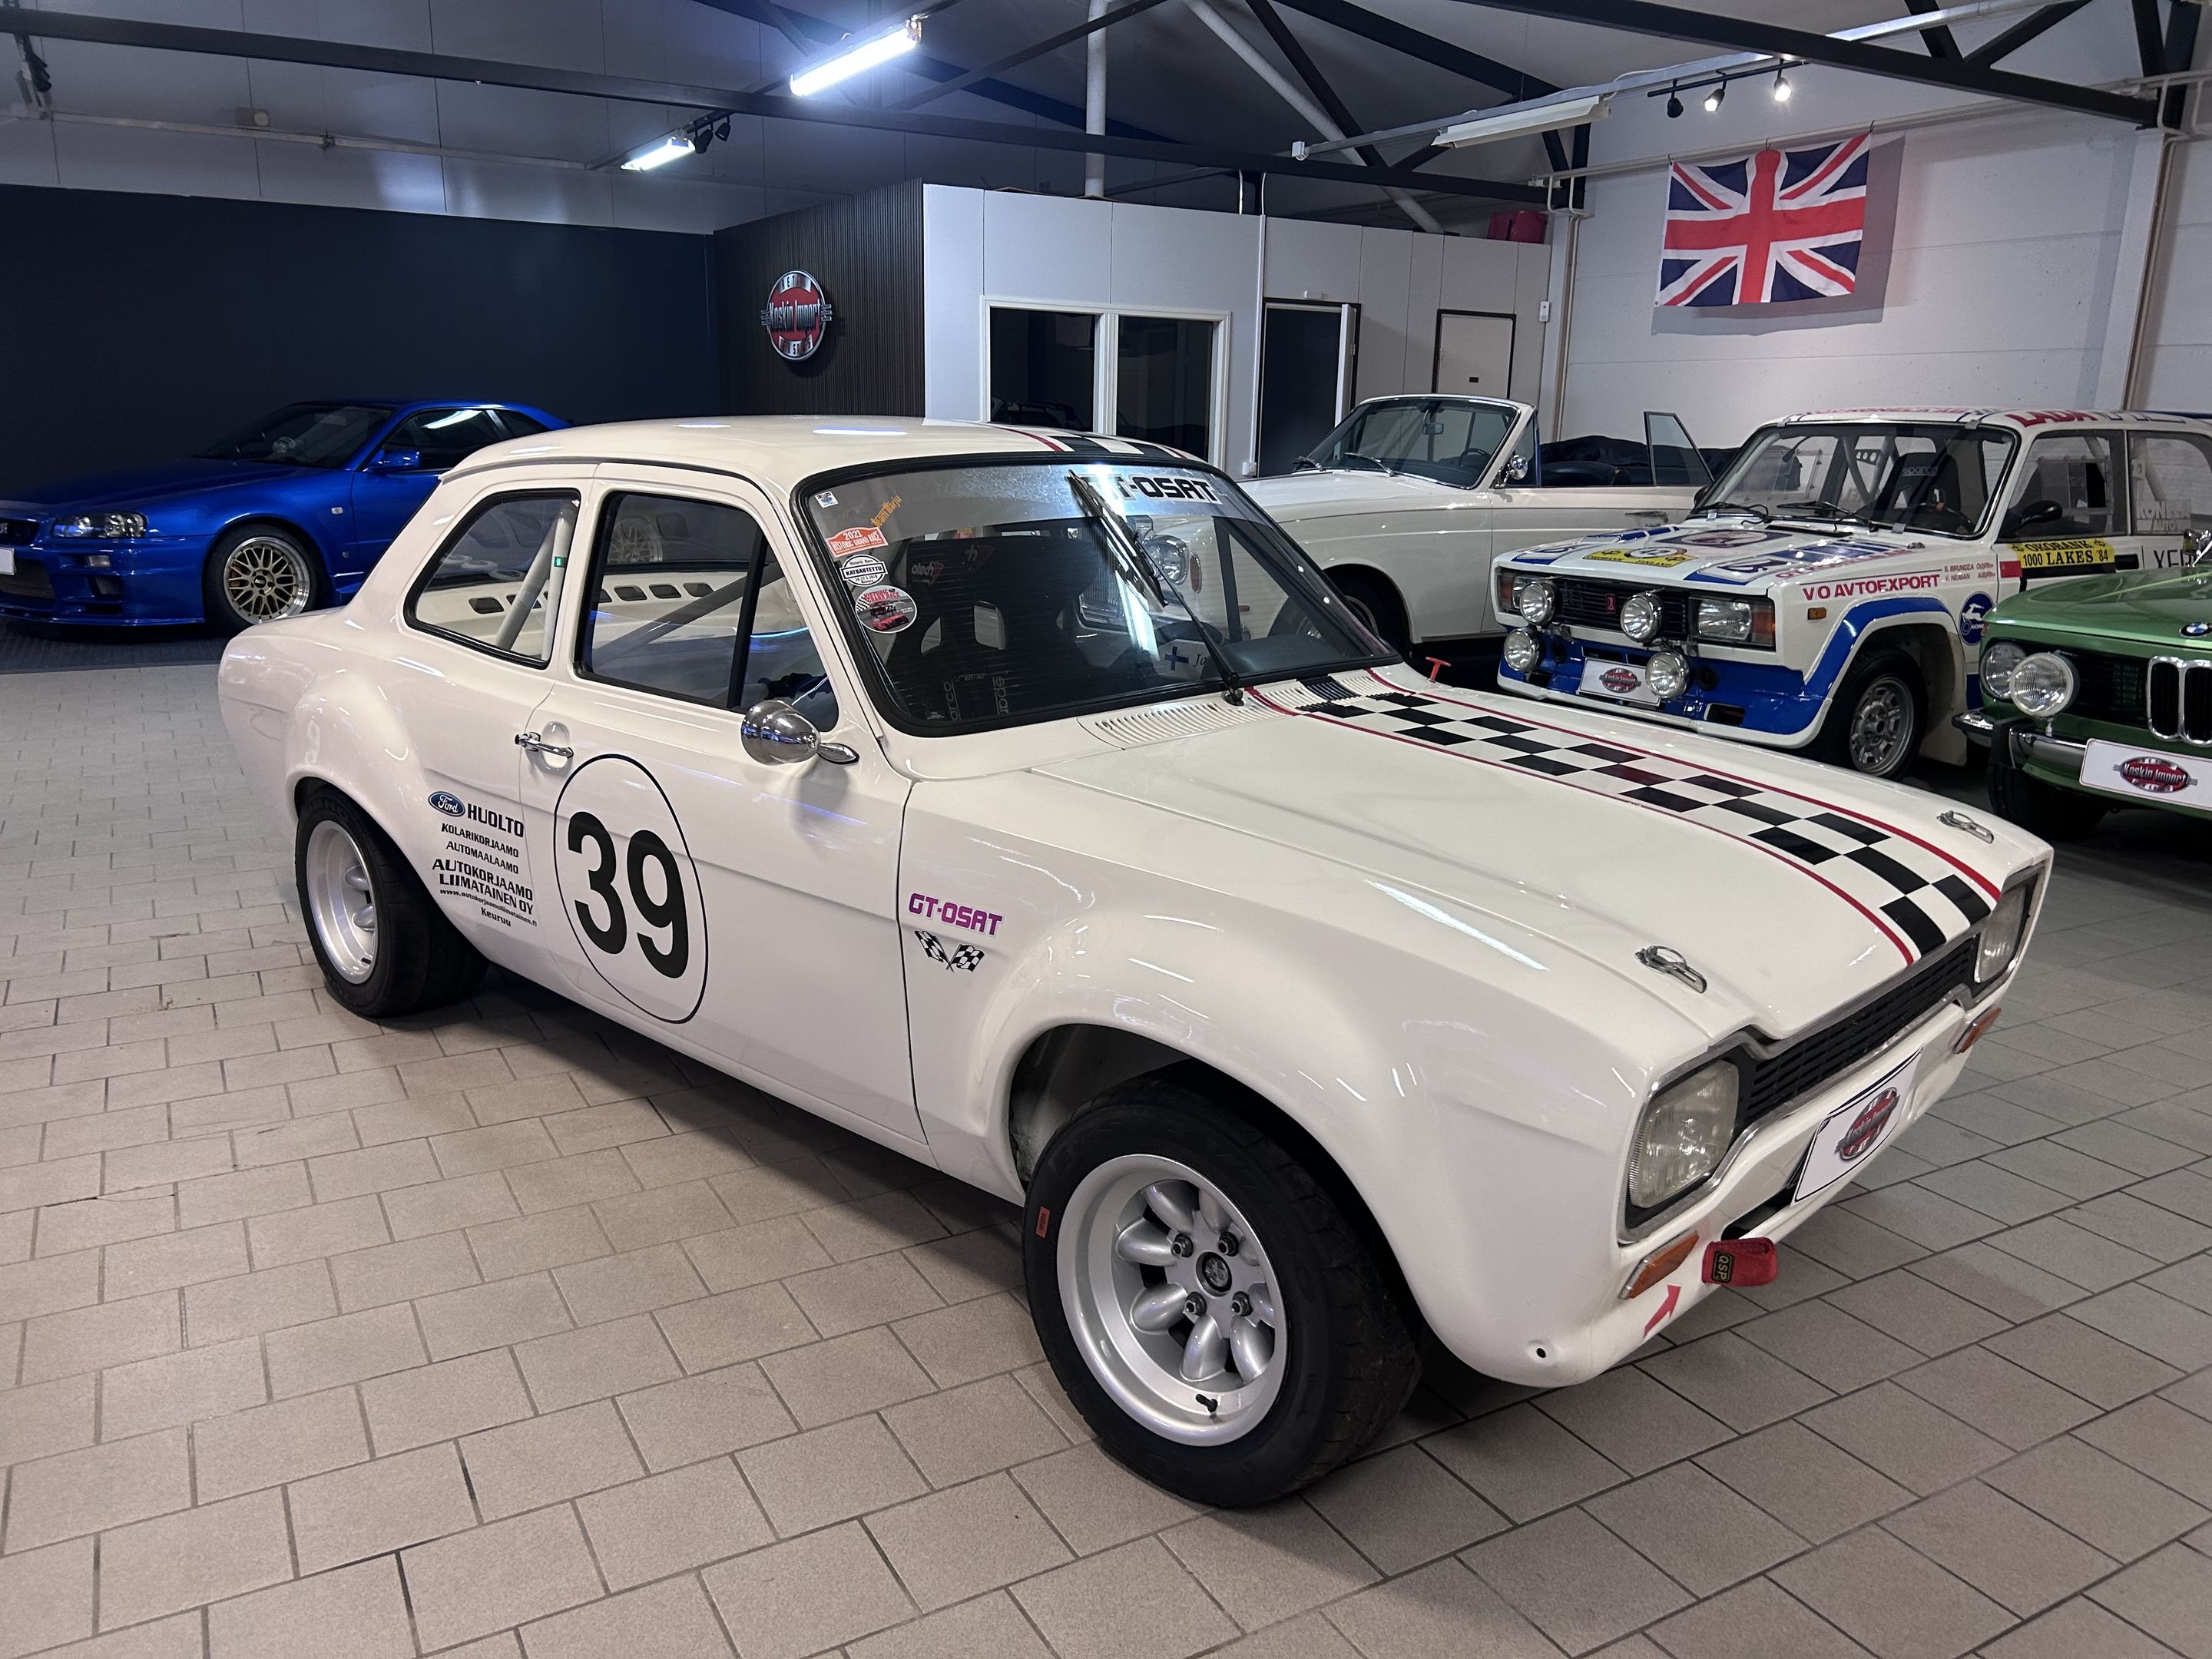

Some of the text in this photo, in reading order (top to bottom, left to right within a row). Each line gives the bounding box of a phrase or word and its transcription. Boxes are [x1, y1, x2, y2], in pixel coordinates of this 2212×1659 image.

[2005, 410, 2098, 428] LADA
[1081, 475, 1219, 502] T-OSAT
[830, 540, 854, 551] HISTORIC
[853, 536, 869, 547] GRAND
[867, 530, 882, 543] RACE
[843, 529, 864, 541] 2021
[845, 566, 882, 576] KATSASTETTU
[1949, 564, 1975, 572] BRUNDZA
[2023, 553, 2043, 567] 1000
[2046, 550, 2094, 565] LAKES
[1834, 574, 1941, 598] AVTOEXPORT
[467, 803, 524, 838] HUOLTO
[441, 823, 519, 858] KOLARIKORJAAMO
[445, 841, 518, 874] AUTOMAALAAMO
[432, 859, 533, 901] AUTOKORJAAMO
[439, 873, 534, 915] LIIMATAINEN OY
[568, 811, 689, 979] 39
[439, 889, 538, 927] www.autokorjaamoliimatainen.fi
[481, 907, 512, 927] Keuruu
[909, 892, 1003, 935] GT-OSAT
[1717, 1255, 1730, 1280] QSP
